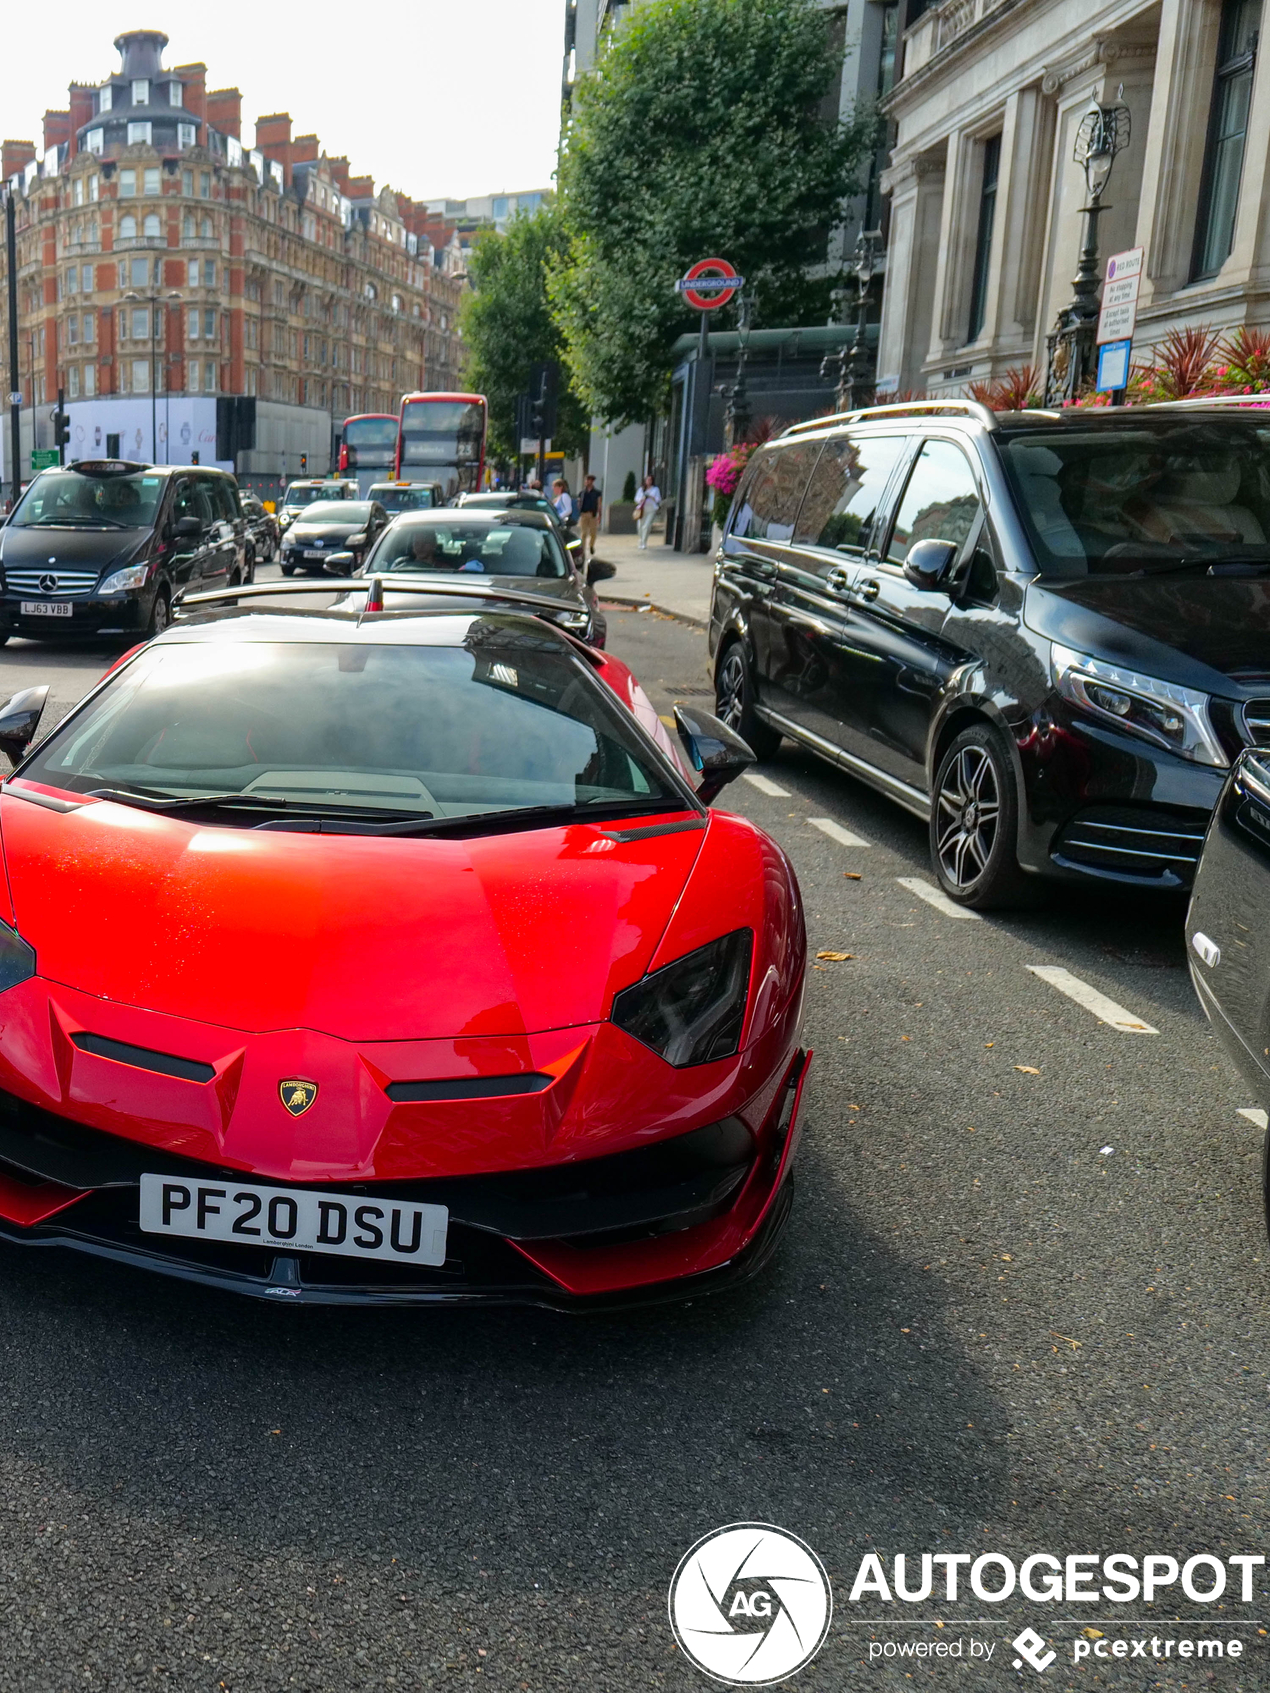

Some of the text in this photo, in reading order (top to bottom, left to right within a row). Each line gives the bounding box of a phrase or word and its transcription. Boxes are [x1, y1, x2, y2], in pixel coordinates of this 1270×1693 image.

[681, 279, 740, 288] UNDERGROUND
[458, 445, 472, 456] 23
[24, 603, 69, 614] LJ63 VBB
[162, 1183, 423, 1254] PF20 DSU
[262, 1238, 294, 1247] Lamborghini
